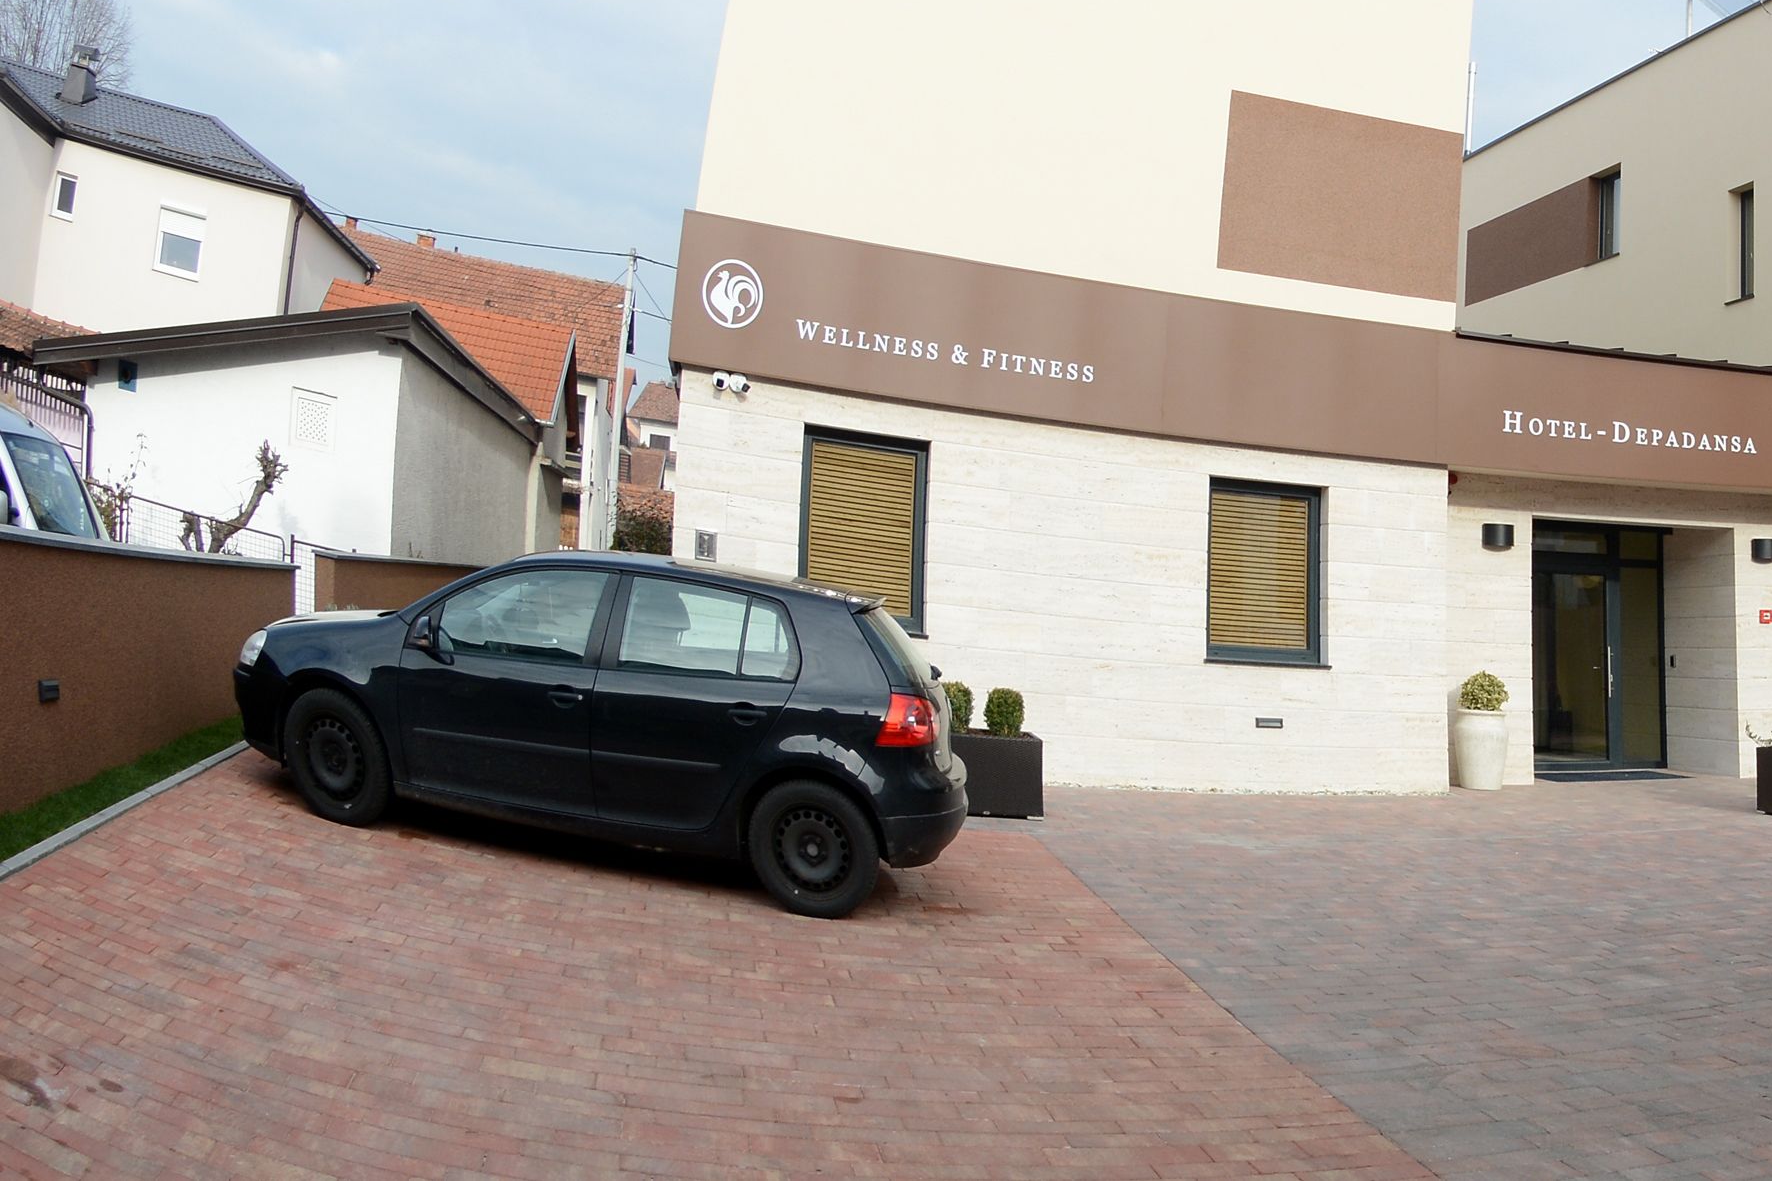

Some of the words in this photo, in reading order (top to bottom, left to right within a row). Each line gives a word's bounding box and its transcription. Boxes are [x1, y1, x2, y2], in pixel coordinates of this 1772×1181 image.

[796, 318, 939, 361] WELLNESS
[951, 344, 969, 366] &
[980, 348, 1096, 383] FITNESS
[1501, 410, 1758, 455] HOTEL-DEPADANSA
